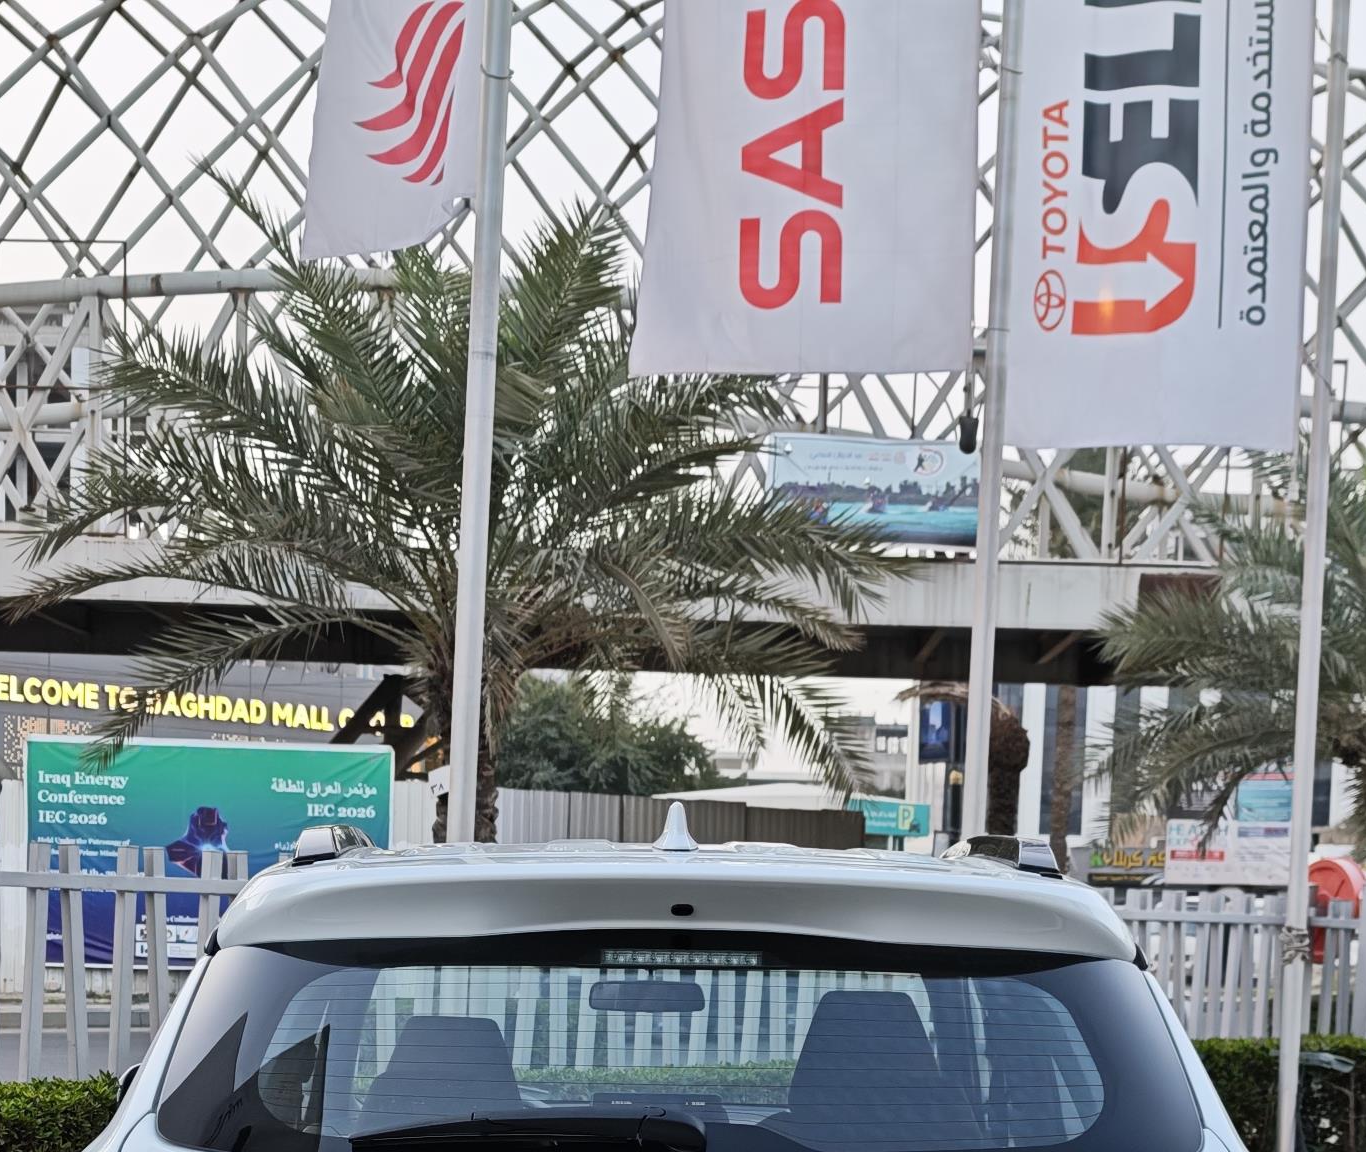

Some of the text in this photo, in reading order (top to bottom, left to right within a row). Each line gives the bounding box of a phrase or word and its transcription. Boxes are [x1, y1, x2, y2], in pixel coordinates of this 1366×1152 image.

[739, 0, 845, 310] SAS
[1042, 100, 1070, 260] TOYOTA
[104, 684, 139, 713] TO
[272, 701, 334, 732] MALL
[38, 770, 130, 789] Iraq Energy
[270, 777, 378, 799] مؤتمر العراق للطاقة
[37, 790, 126, 806] Conference
[38, 810, 108, 826] IEC 2026
[307, 803, 376, 819] IEC 2026
